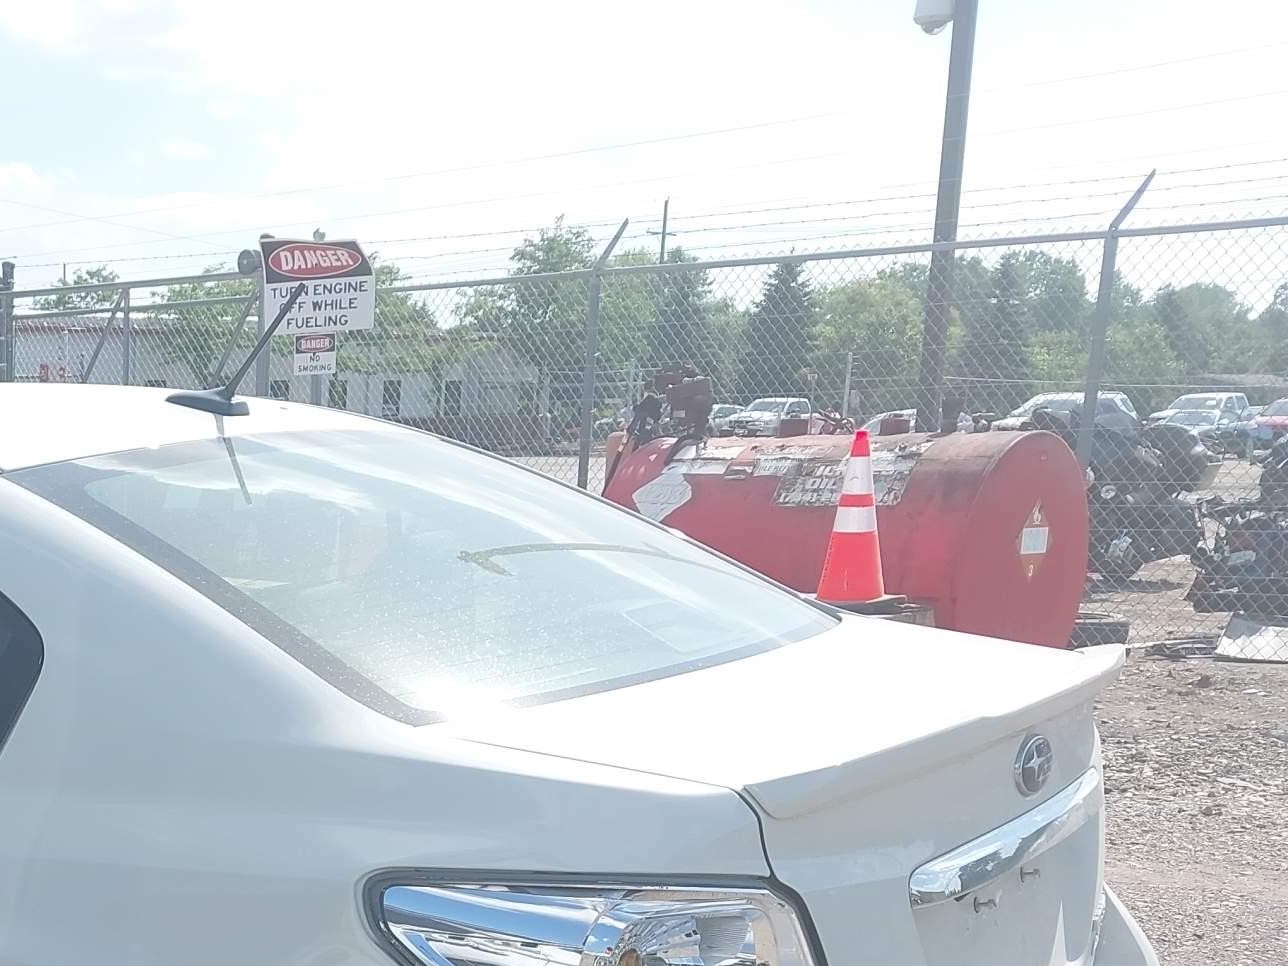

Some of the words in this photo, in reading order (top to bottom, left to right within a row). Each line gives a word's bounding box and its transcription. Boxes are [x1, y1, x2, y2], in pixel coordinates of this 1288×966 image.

[279, 249, 354, 271] DANGER
[313, 280, 368, 296] ENGINE
[312, 297, 358, 312] WHILE
[286, 314, 349, 330] FUELING
[301, 338, 330, 349] DANGER
[309, 354, 321, 362] NO
[298, 363, 332, 373] SMOKING
